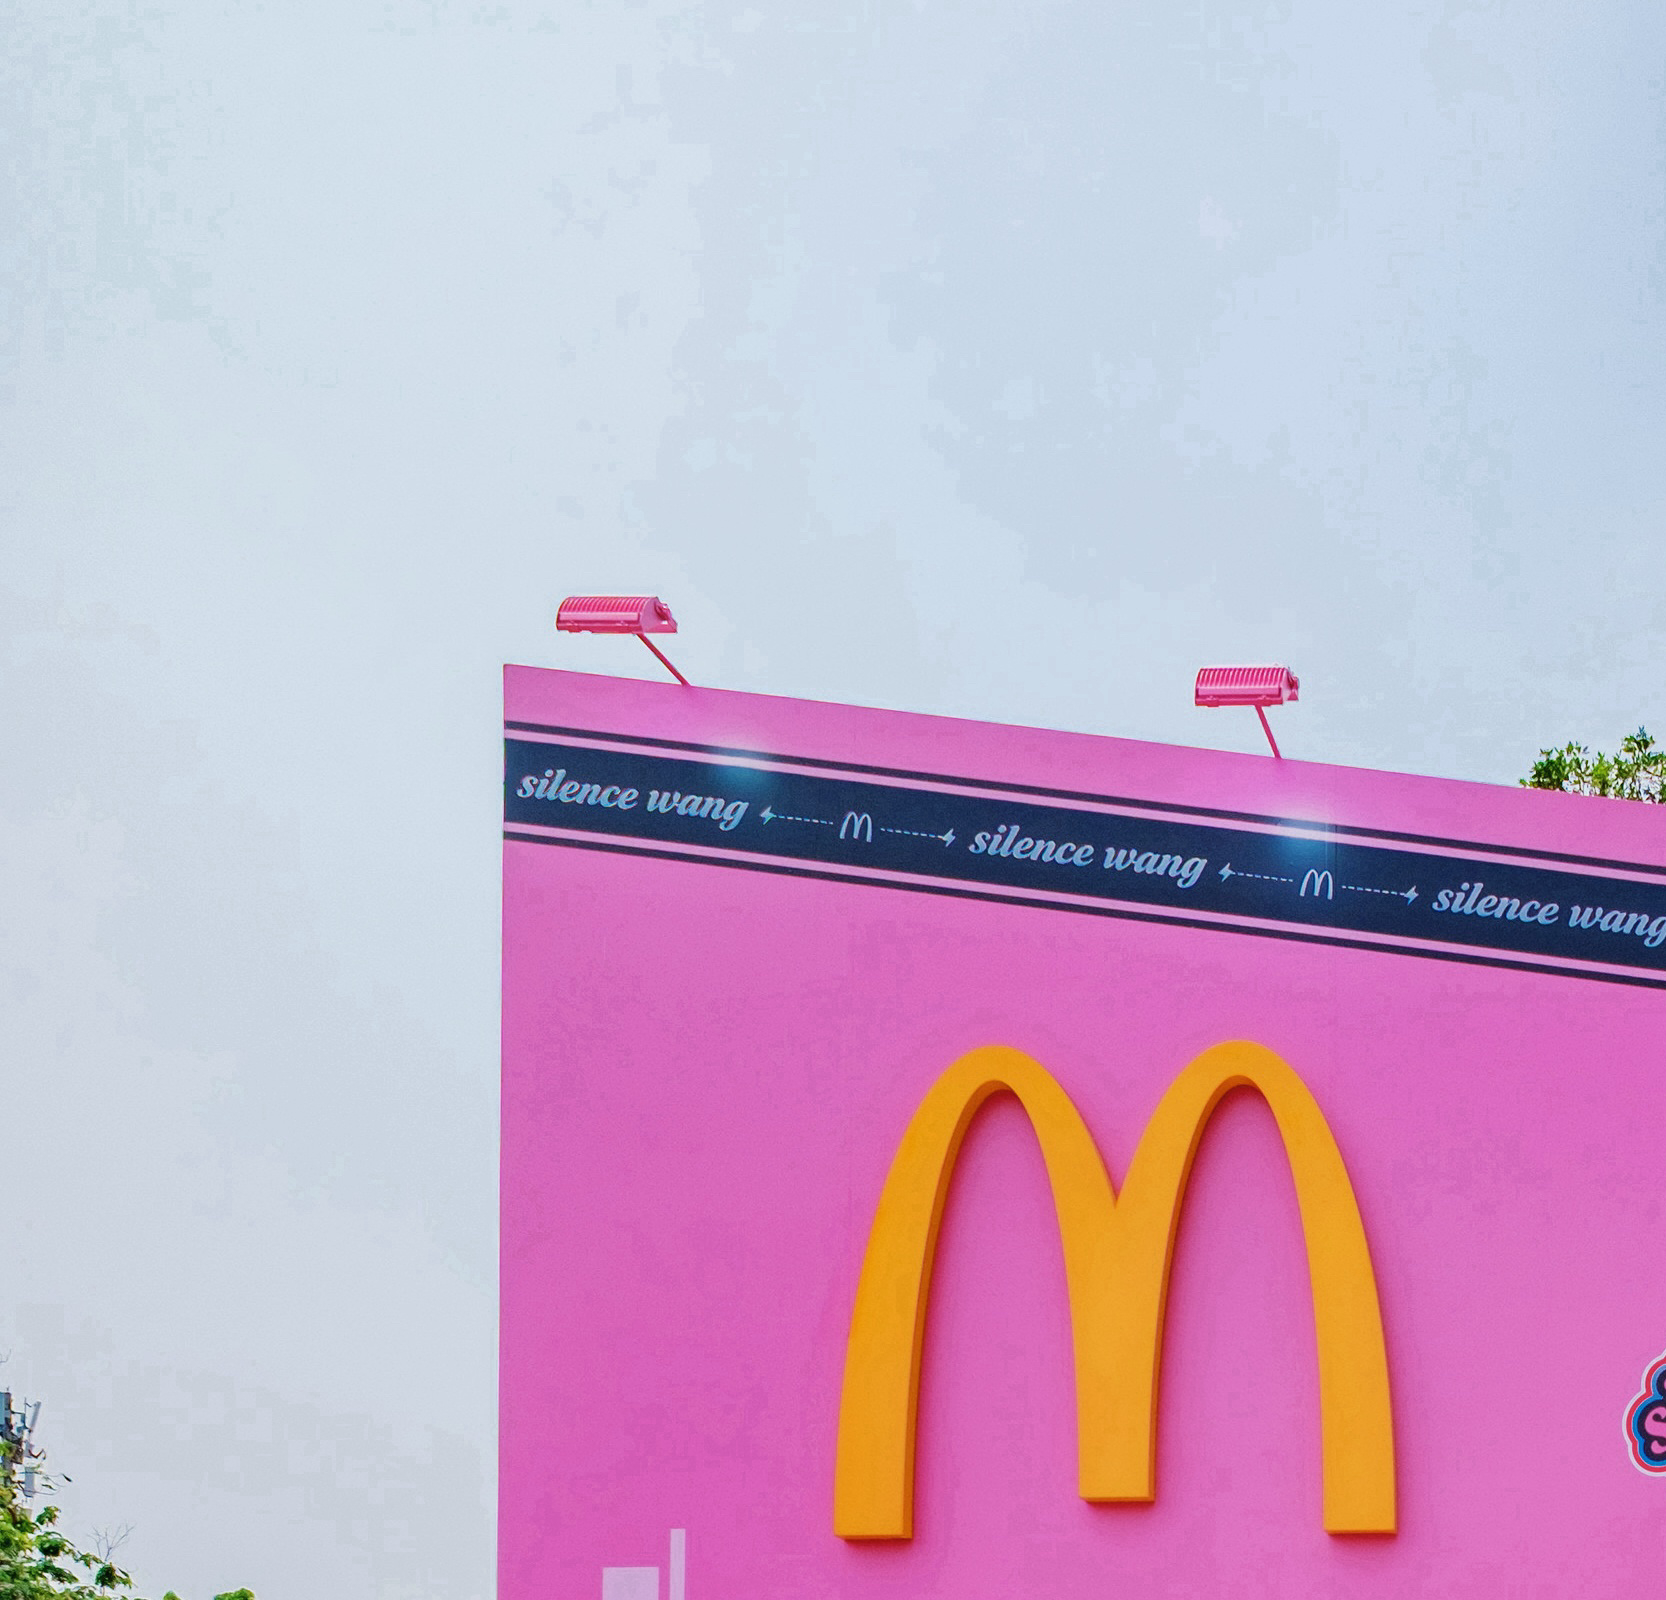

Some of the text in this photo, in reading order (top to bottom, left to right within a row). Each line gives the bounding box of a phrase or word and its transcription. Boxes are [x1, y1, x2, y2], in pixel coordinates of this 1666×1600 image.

[516, 768, 638, 811] silence
[646, 790, 750, 832] wang
[968, 825, 1095, 866] silence
[1104, 844, 1208, 889] wang
[1431, 882, 1560, 925] silence
